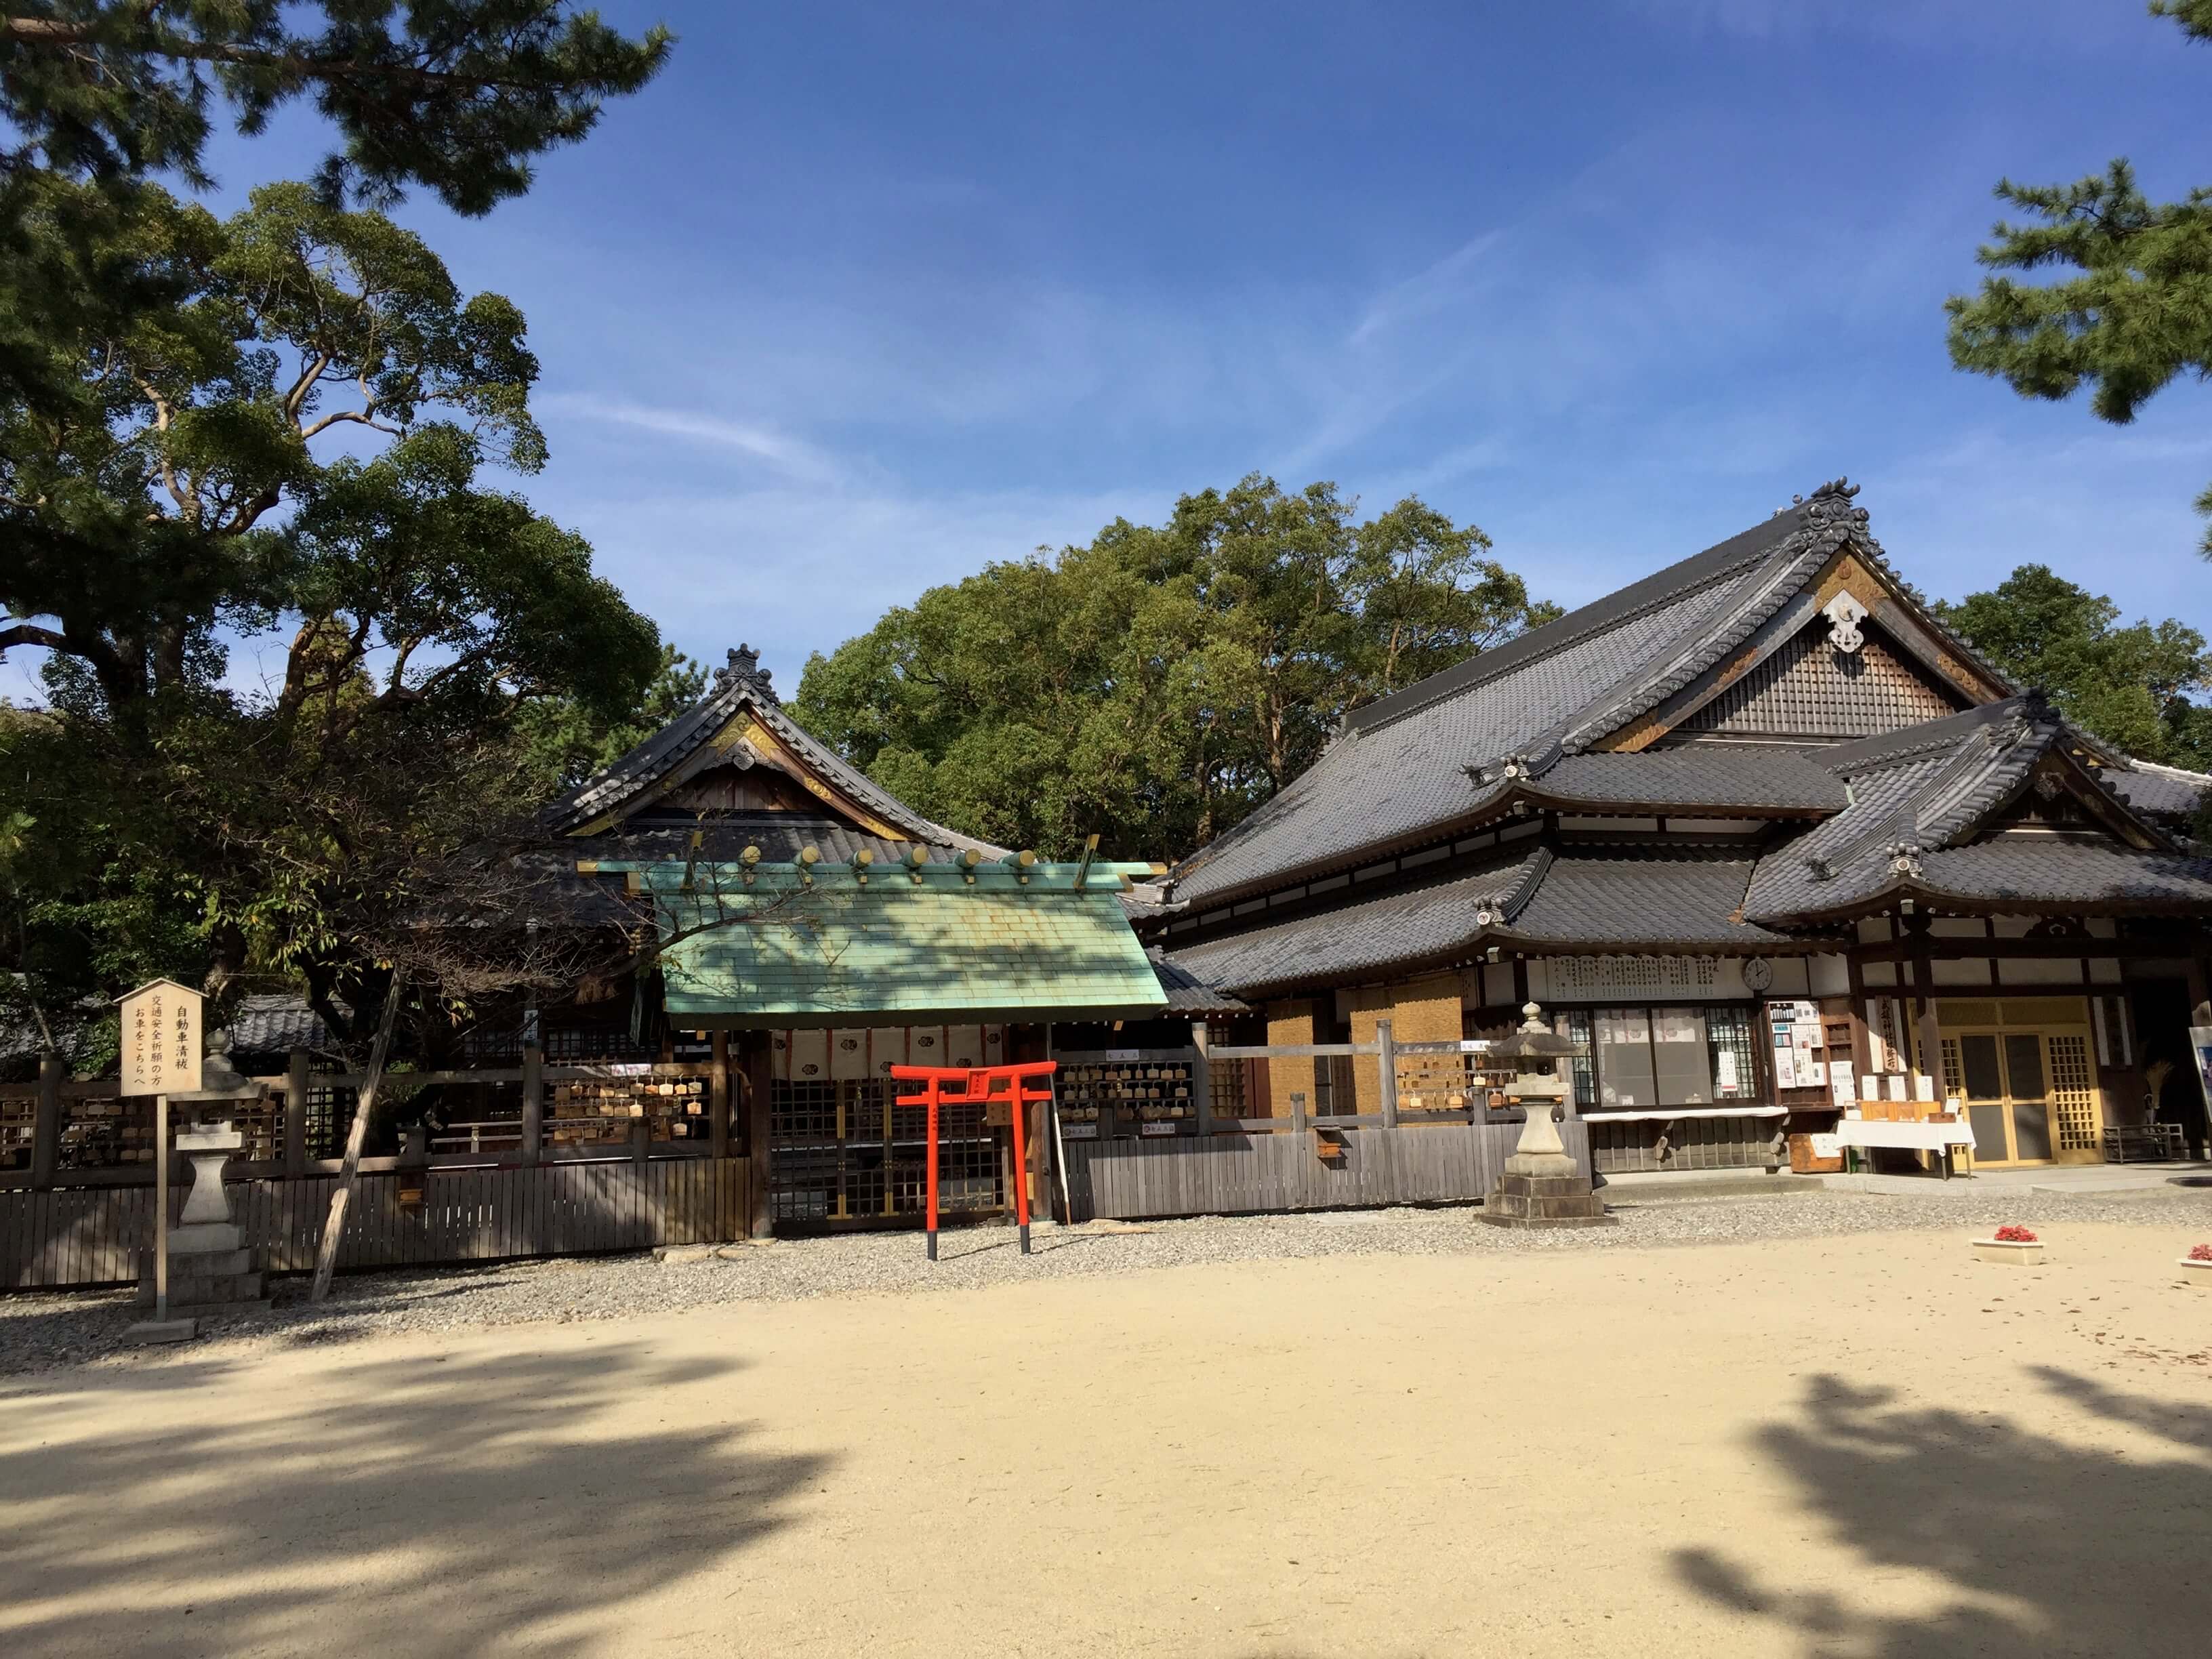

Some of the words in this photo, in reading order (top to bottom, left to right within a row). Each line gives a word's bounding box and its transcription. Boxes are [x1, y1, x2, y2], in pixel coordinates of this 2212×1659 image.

[134, 1008, 146, 1085] お車をこちらへ
[150, 994, 163, 1086] 交通安全祈願の方
[175, 1005, 189, 1070] 自動車清祓
